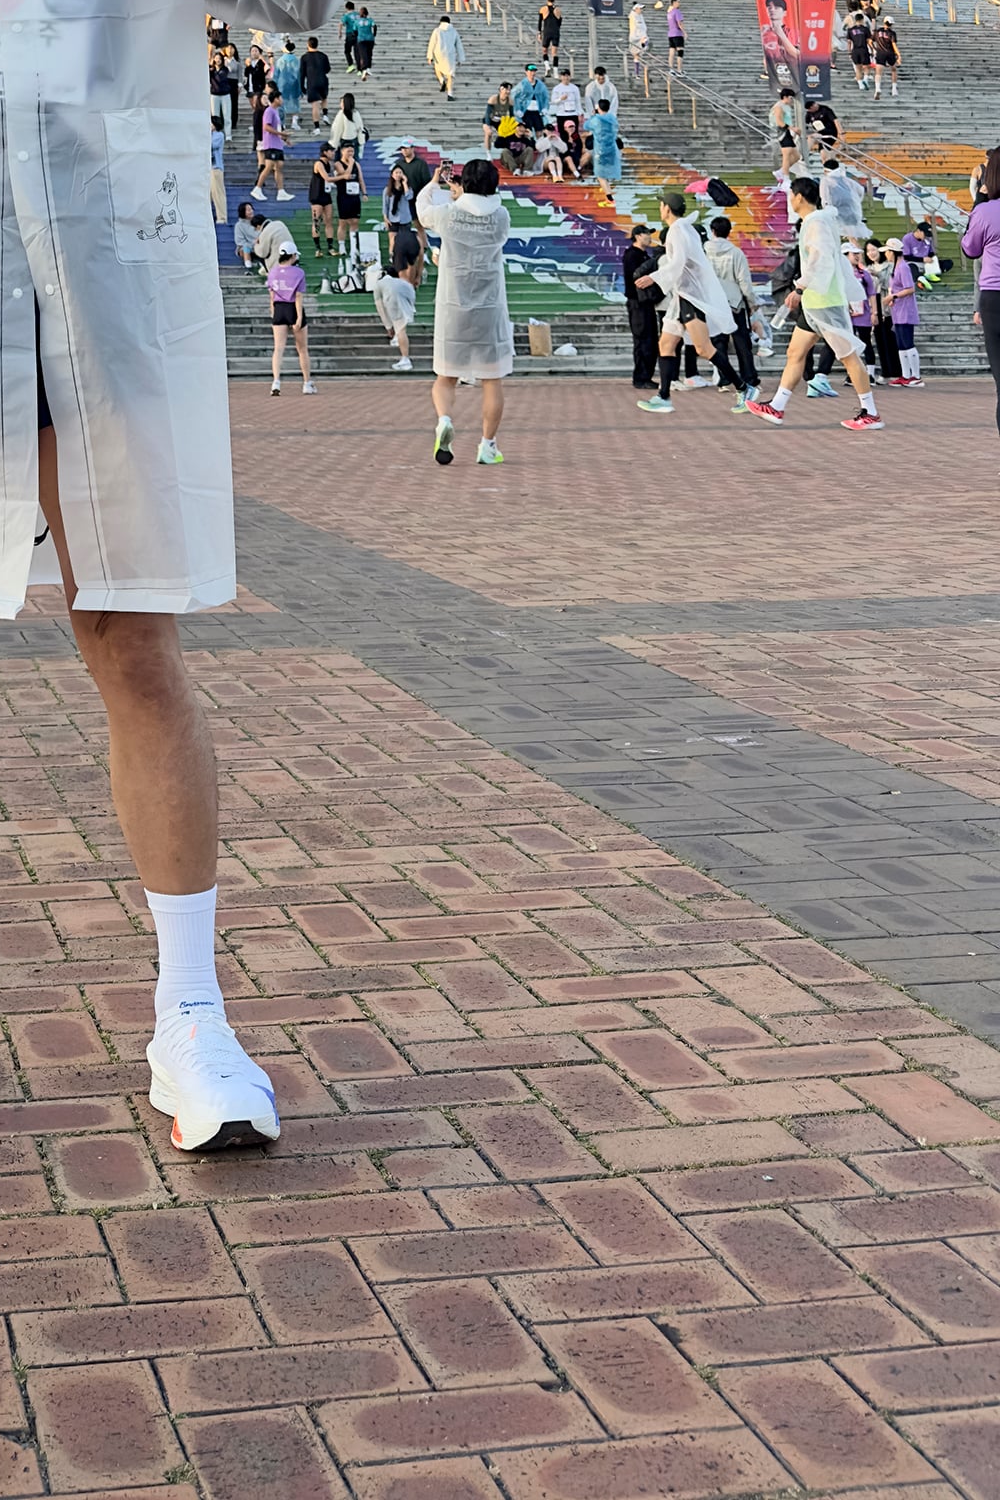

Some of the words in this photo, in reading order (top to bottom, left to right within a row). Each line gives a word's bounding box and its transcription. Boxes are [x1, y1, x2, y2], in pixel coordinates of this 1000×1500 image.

[807, 31, 818, 51] 6
[449, 211, 498, 225] OREGON
[448, 221, 497, 234] PROJECT
